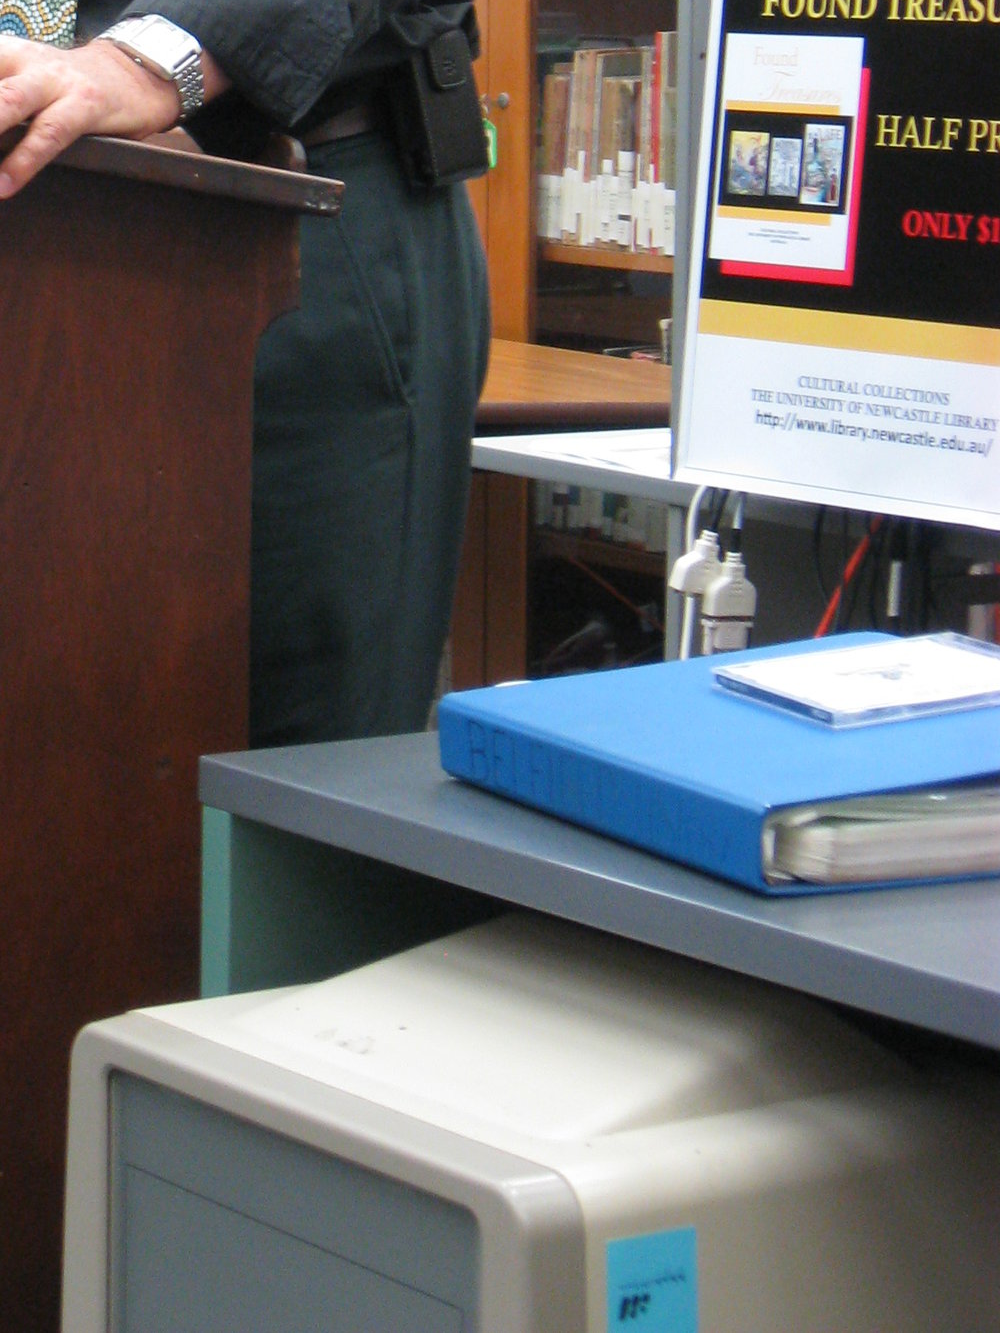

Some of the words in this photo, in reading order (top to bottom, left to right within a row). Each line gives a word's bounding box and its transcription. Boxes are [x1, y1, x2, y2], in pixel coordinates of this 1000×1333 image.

[875, 114, 963, 150] HALF
[901, 209, 974, 241] ONLY
[798, 375, 861, 395] CULTURAL
[863, 383, 951, 406] COLLECTIONS
[751, 388, 774, 403] THE
[776, 391, 846, 412] UNIVERSITY
[847, 400, 864, 414] OF
[865, 402, 942, 424] NEWCASTLE
[943, 412, 999, 432] LIBRARY
[754, 409, 994, 458] http://www.library.newcastle.edu.au/
